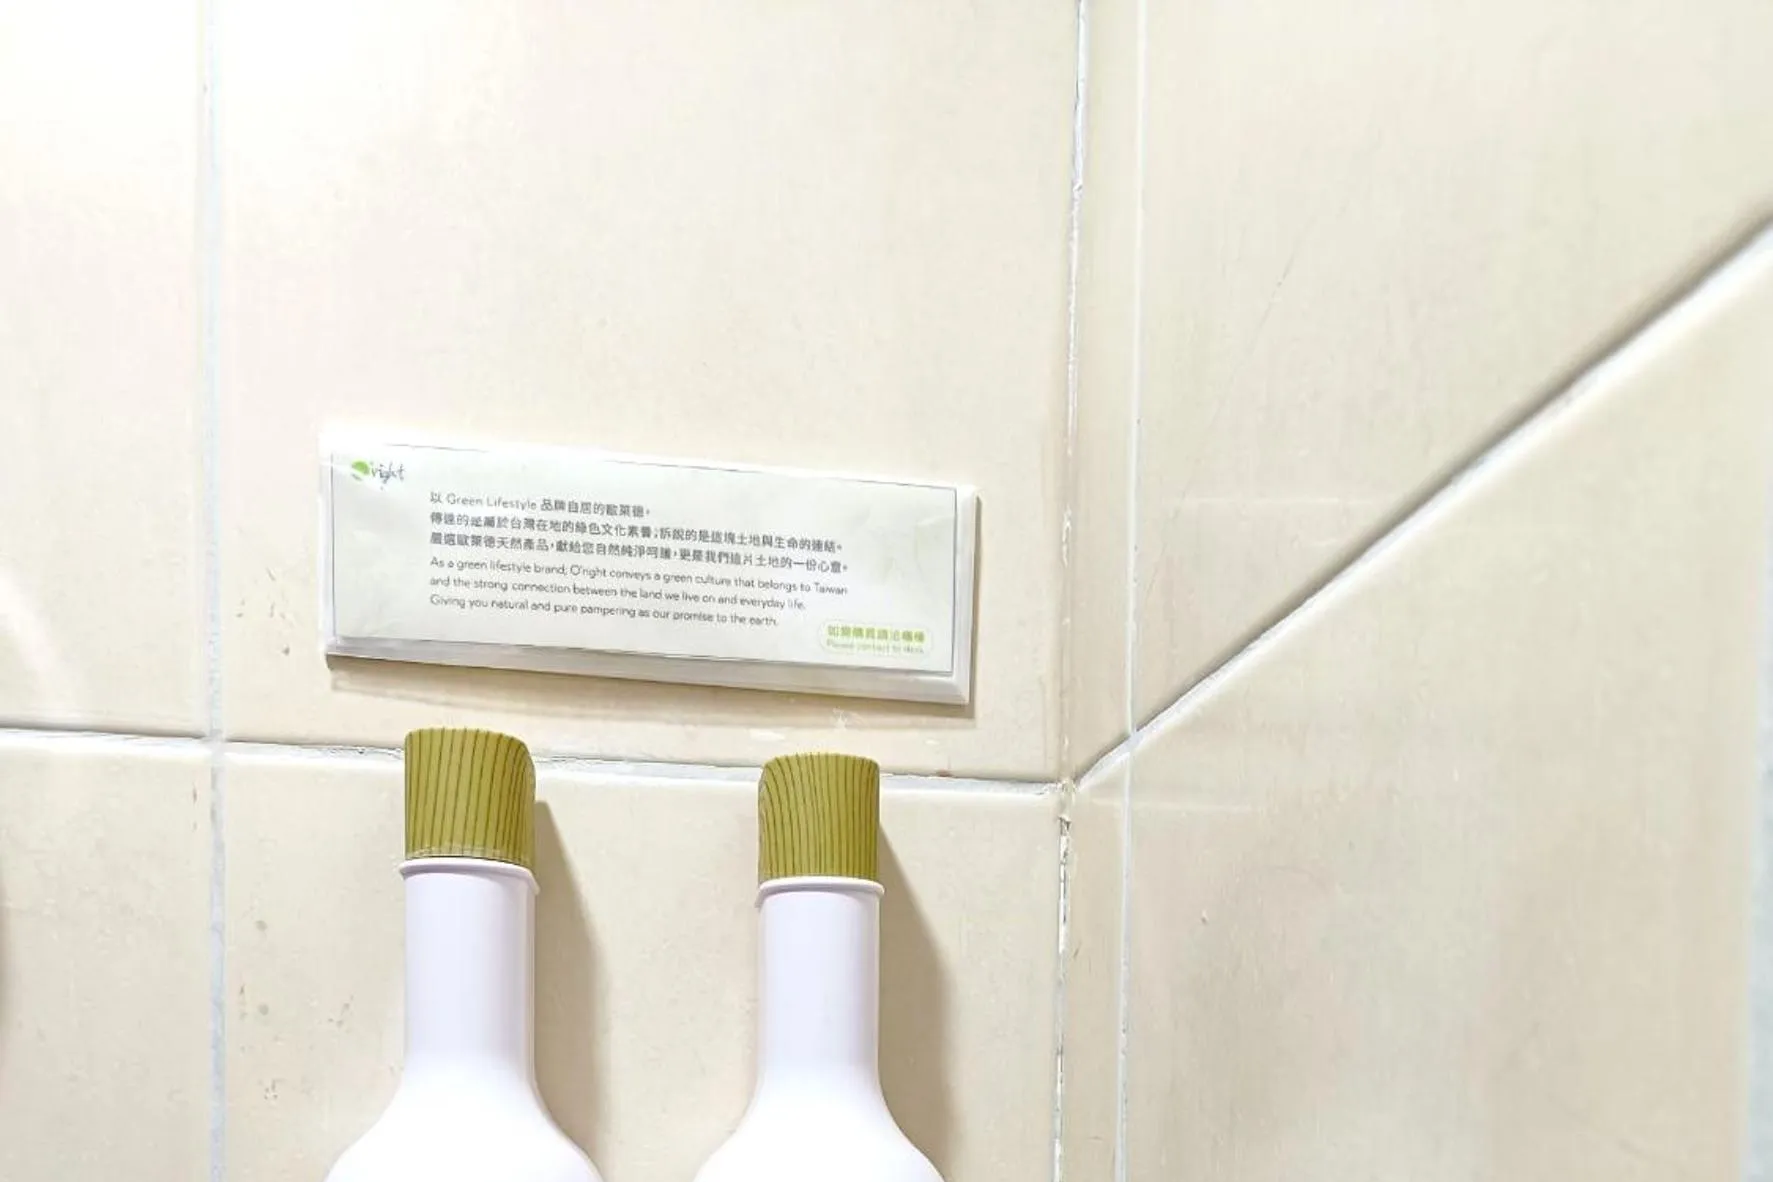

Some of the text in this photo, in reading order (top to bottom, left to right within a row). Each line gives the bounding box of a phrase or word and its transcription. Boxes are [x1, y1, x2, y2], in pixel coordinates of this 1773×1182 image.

[430, 491, 442, 504] 以
[446, 492, 483, 506] Green
[486, 496, 537, 511] Lifestyle
[430, 556, 445, 568] As
[447, 560, 455, 568] a
[456, 560, 488, 571] green
[490, 559, 532, 573] lifestyle
[570, 564, 607, 579] O'right
[609, 569, 652, 581] conveys
[654, 572, 661, 580] a
[663, 573, 693, 584] green
[695, 575, 732, 587] culture
[734, 577, 755, 588] that
[758, 579, 797, 593] belongs
[800, 583, 811, 592] to
[814, 582, 848, 595] Taiwan
[430, 576, 450, 587] and
[453, 578, 471, 588] the
[474, 579, 508, 592] strong
[512, 581, 571, 594] connection
[573, 583, 618, 597] between
[620, 588, 638, 598] the
[640, 588, 663, 600] land
[665, 592, 680, 601] we
[682, 591, 700, 602] live
[702, 594, 716, 603] on
[718, 594, 738, 604] and
[740, 597, 786, 610] everyday
[430, 594, 466, 609] Giving
[469, 599, 489, 610] you
[491, 599, 529, 610] natural
[531, 600, 551, 612] and
[554, 603, 578, 614] pure
[581, 605, 636, 619] pampering
[638, 608, 651, 618] as
[652, 610, 670, 619] our
[673, 611, 714, 622] promise
[716, 612, 727, 623] to
[730, 612, 746, 624] the
